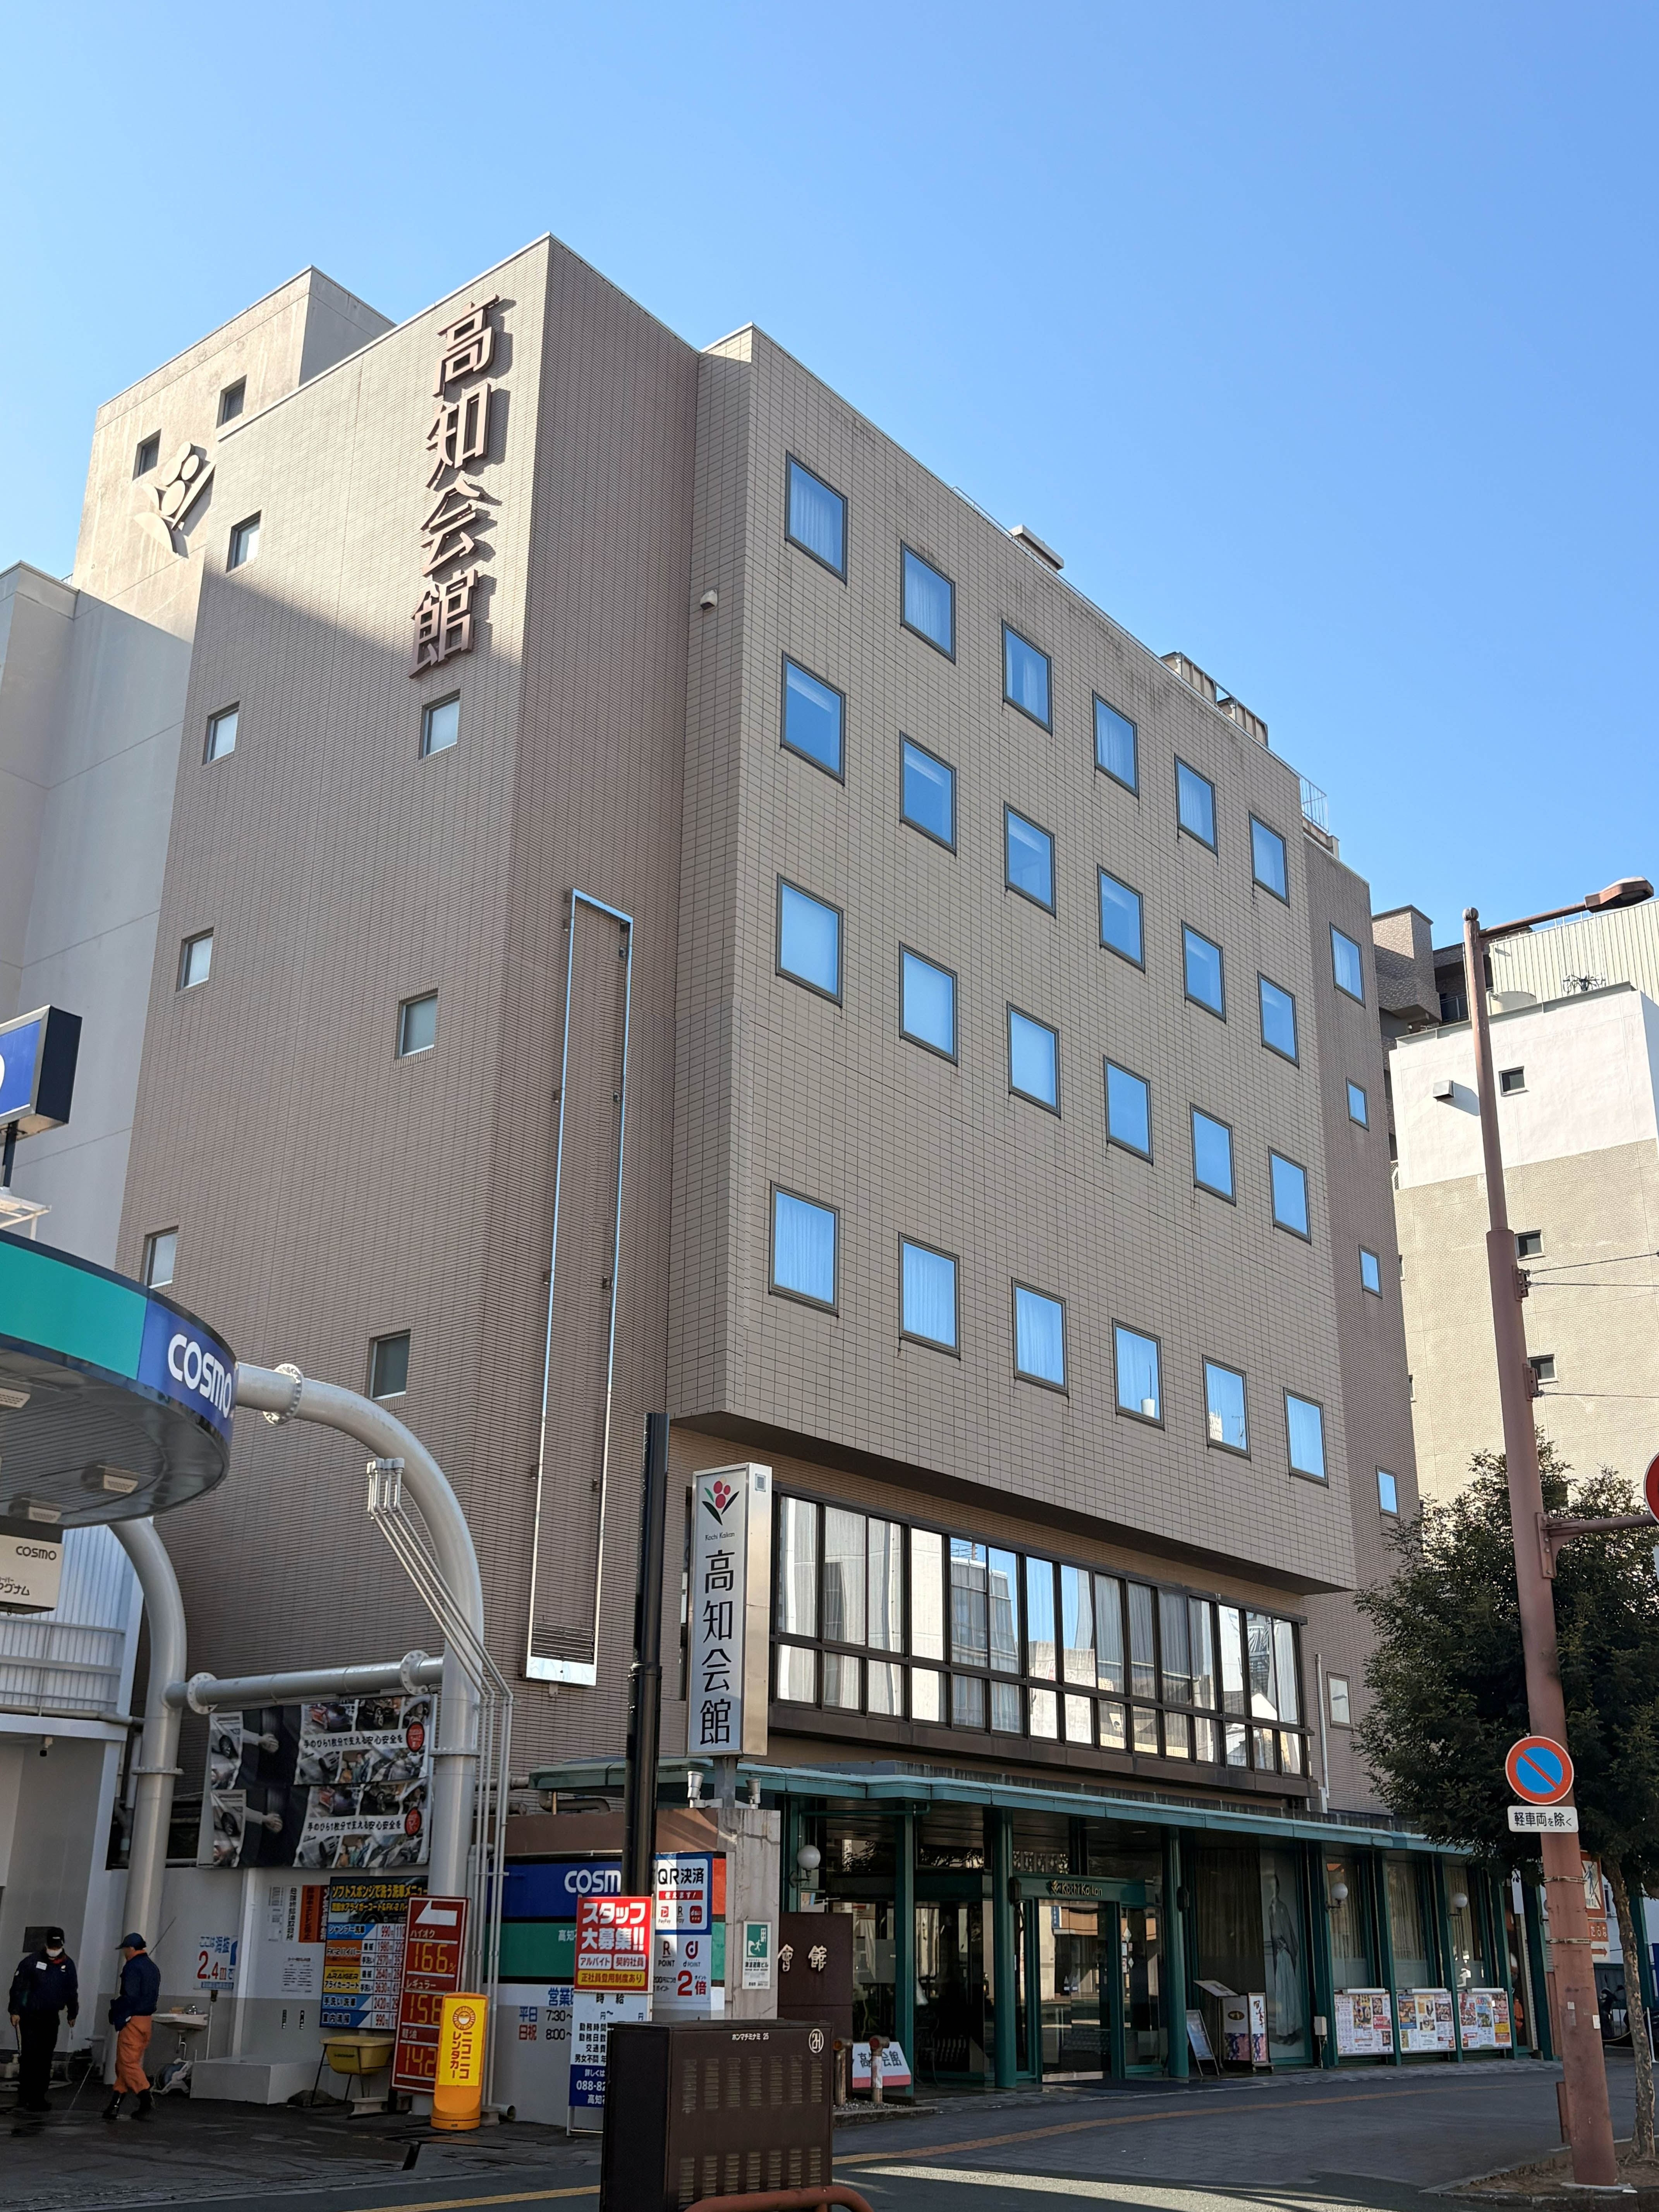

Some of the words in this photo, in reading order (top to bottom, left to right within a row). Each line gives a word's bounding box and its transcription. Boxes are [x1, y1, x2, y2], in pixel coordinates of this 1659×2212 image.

[408, 293, 501, 678] 高知会館
[168, 1334, 232, 1418] COSMO
[16, 1546, 57, 1560] COSMO
[699, 1549, 735, 1746] 高知会館
[1513, 1812, 1572, 1827] 軽車両を除く
[564, 1870, 621, 1893] COSM
[658, 1867, 704, 1885] QR決済
[1062, 1882, 1080, 1895] Kochi
[1081, 1883, 1103, 1896] Kaikan
[582, 1903, 646, 1924] スタッフ
[410, 1929, 436, 1939] ハイオク
[558, 1930, 577, 1942] 高知
[581, 1927, 645, 1951] 大募集!!
[413, 1942, 448, 1973] 166
[616, 1957, 644, 1967] 契約社員
[406, 1979, 437, 1990] レギュラー
[581, 1973, 642, 1983] 正社員登用制度あり
[677, 1970, 693, 1996] 2
[695, 1980, 707, 1995] 倍
[548, 1987, 574, 2006] 営業
[519, 2006, 538, 2022] 平日
[638, 2012, 644, 2021] 円
[519, 2024, 537, 2040] 日祝
[579, 2023, 607, 2032] 勤務時間
[579, 2033, 606, 2042] 勤務日数
[450, 2031, 462, 2079] レンタカー
[459, 2031, 473, 2079] ニコニコ
[586, 2044, 606, 2053] 交通費
[574, 2054, 599, 2063] 男女不問
[585, 2069, 606, 2077] 詳しくは
[587, 2094, 605, 2104] 高知
